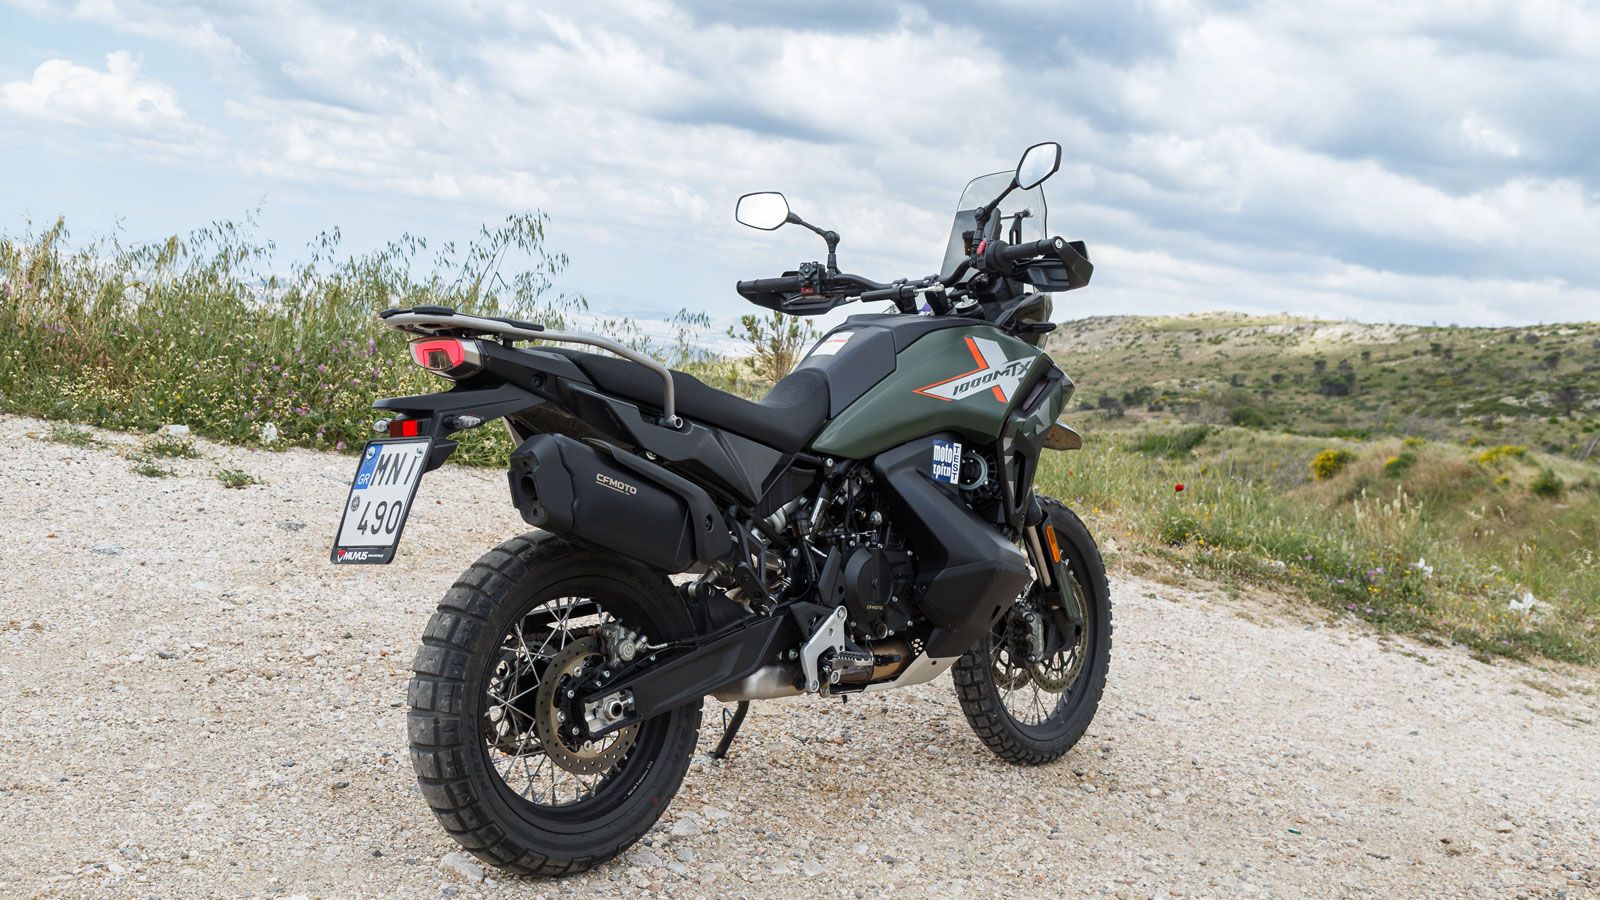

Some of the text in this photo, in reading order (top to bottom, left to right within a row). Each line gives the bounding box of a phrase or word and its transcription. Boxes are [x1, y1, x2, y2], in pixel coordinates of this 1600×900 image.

[952, 360, 1031, 396] 1000MTX
[933, 444, 953, 464] moto
[951, 445, 960, 481] TEST
[358, 474, 370, 485] GR
[596, 473, 637, 495] CFMOTO
[357, 500, 402, 535] 490
